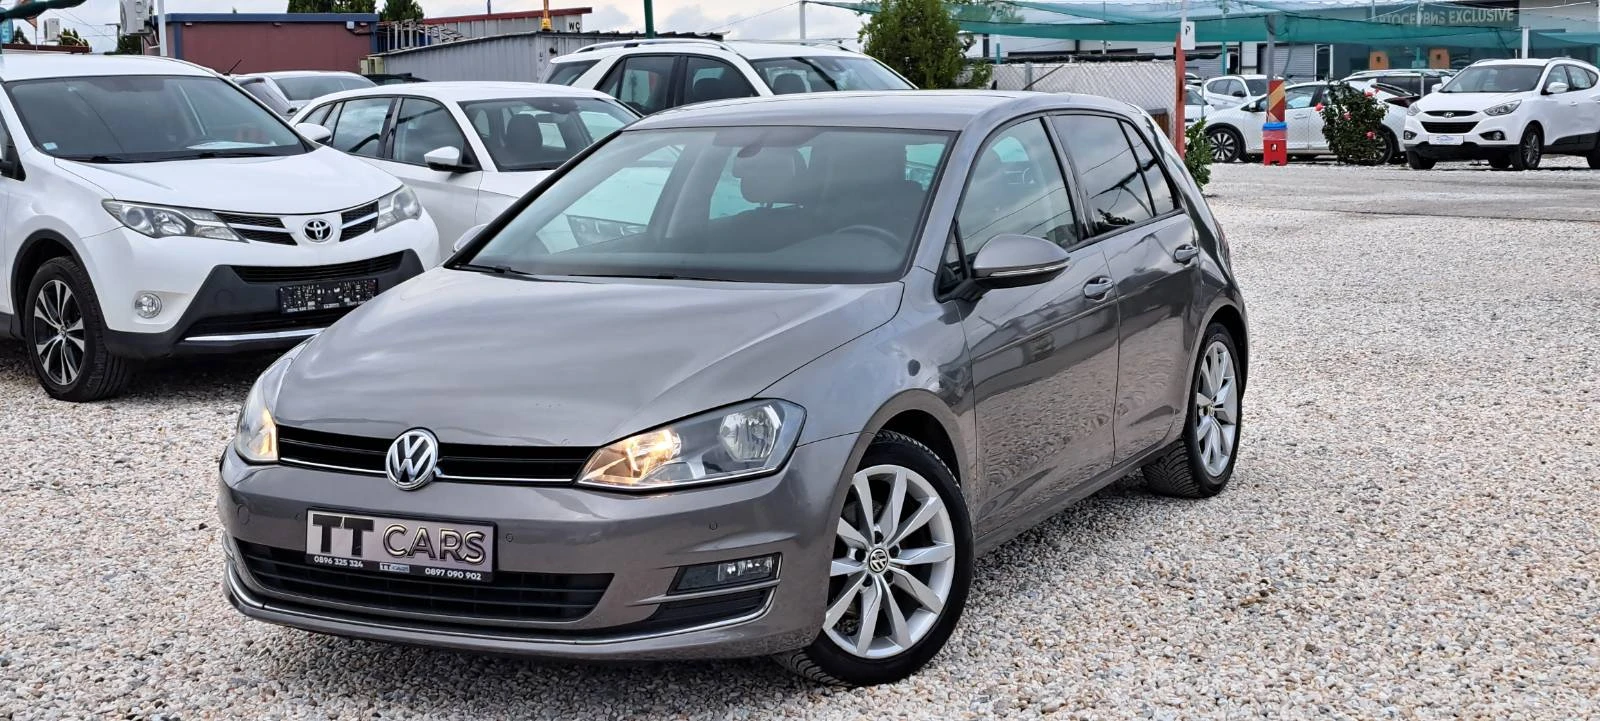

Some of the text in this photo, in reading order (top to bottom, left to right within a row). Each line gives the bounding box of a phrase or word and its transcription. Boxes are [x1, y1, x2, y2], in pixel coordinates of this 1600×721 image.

[1449, 8, 1514, 24] EXCLUSIVE
[569, 21, 580, 30] WC
[312, 513, 486, 565] TT CARS
[313, 555, 333, 565] 0896
[334, 558, 348, 566] 325
[425, 567, 481, 581] 0897 090 902
